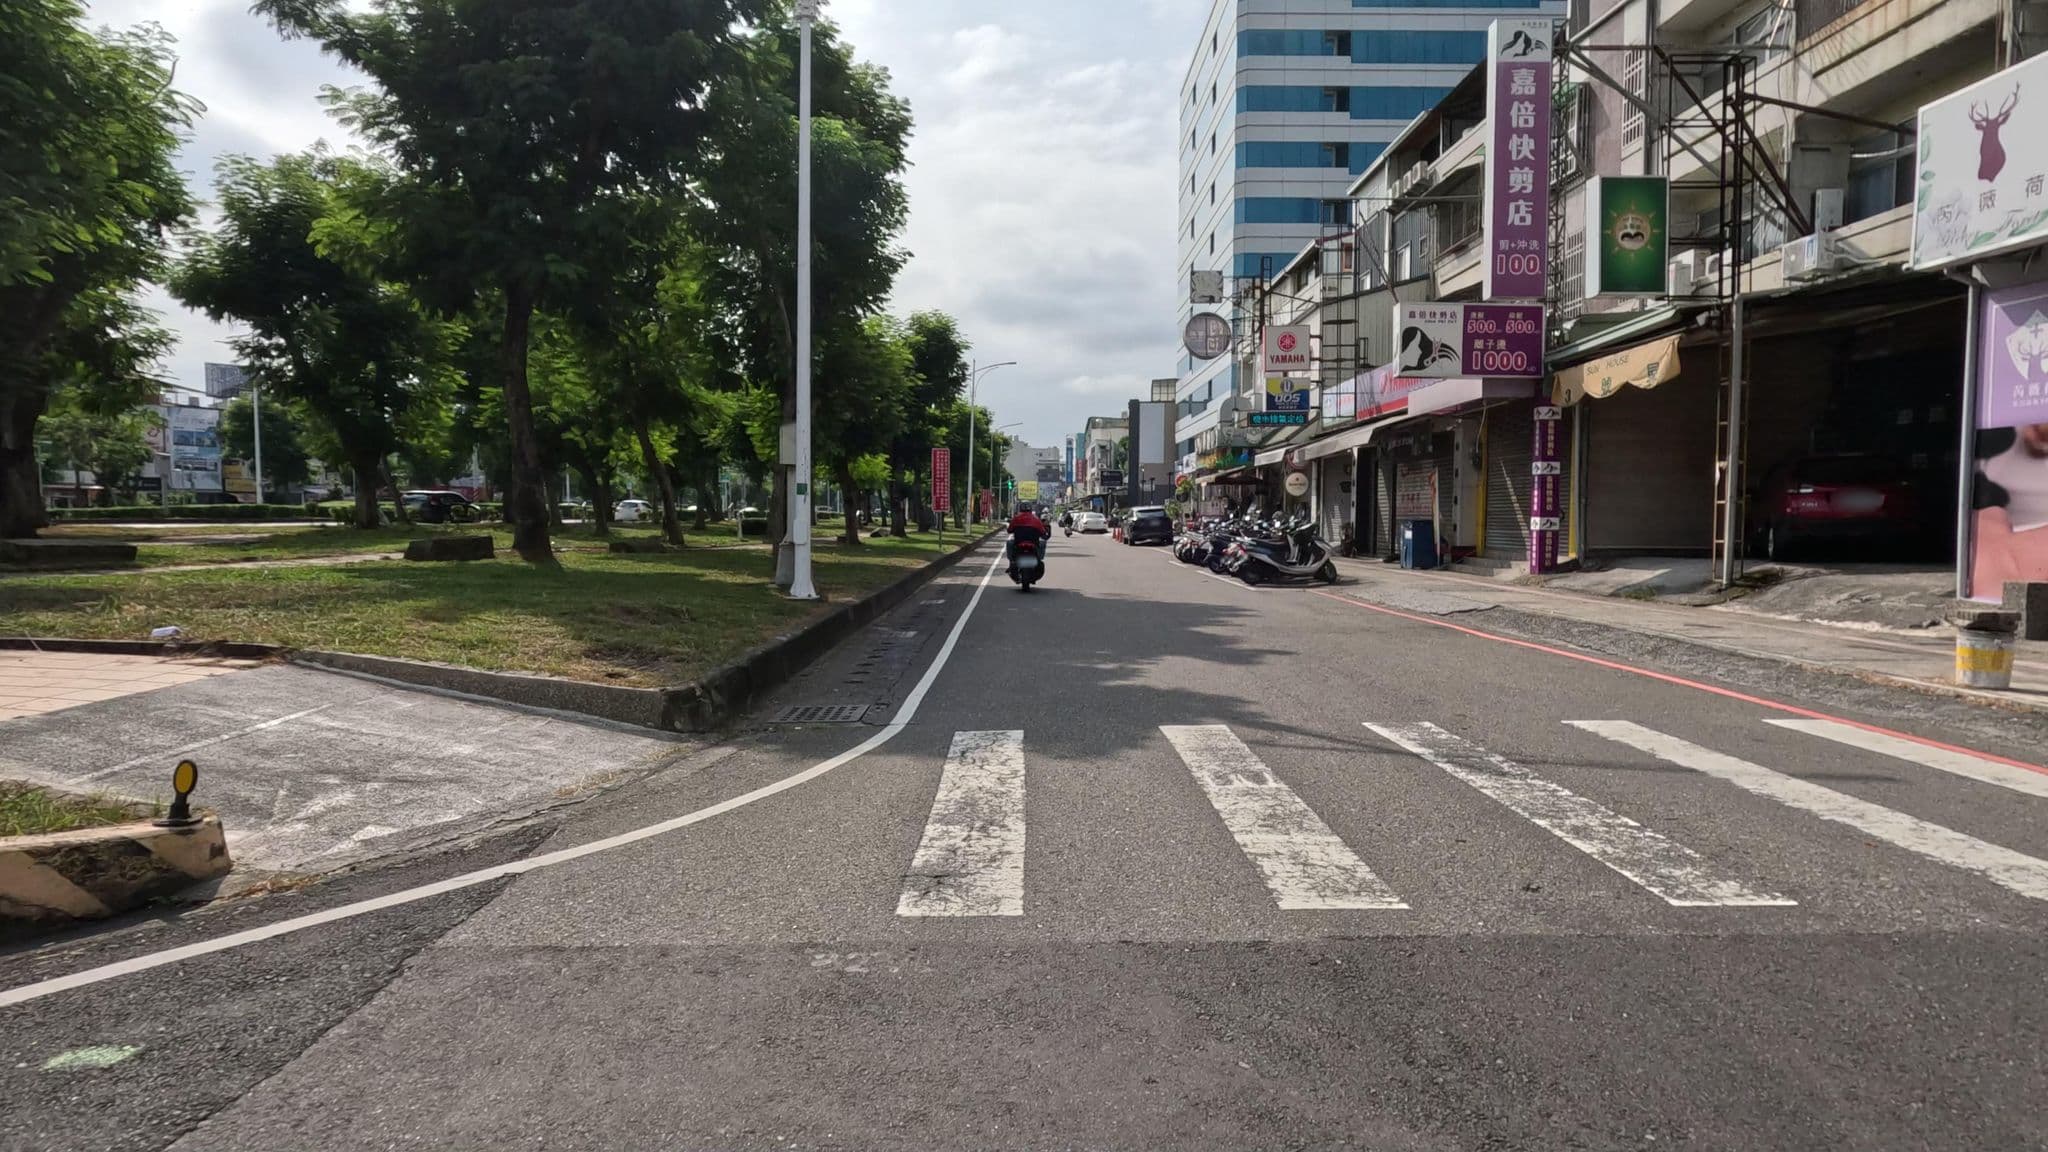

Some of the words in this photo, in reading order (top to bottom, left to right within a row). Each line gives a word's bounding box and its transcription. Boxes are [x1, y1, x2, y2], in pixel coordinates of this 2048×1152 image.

[1507, 68, 1537, 226] 嘉倍快剪店
[1496, 253, 1540, 275] 100
[1467, 320, 1496, 334] 500
[1505, 320, 1535, 334] 500
[1270, 354, 1305, 364] YAMAHA
[1472, 351, 1527, 371] 1000
